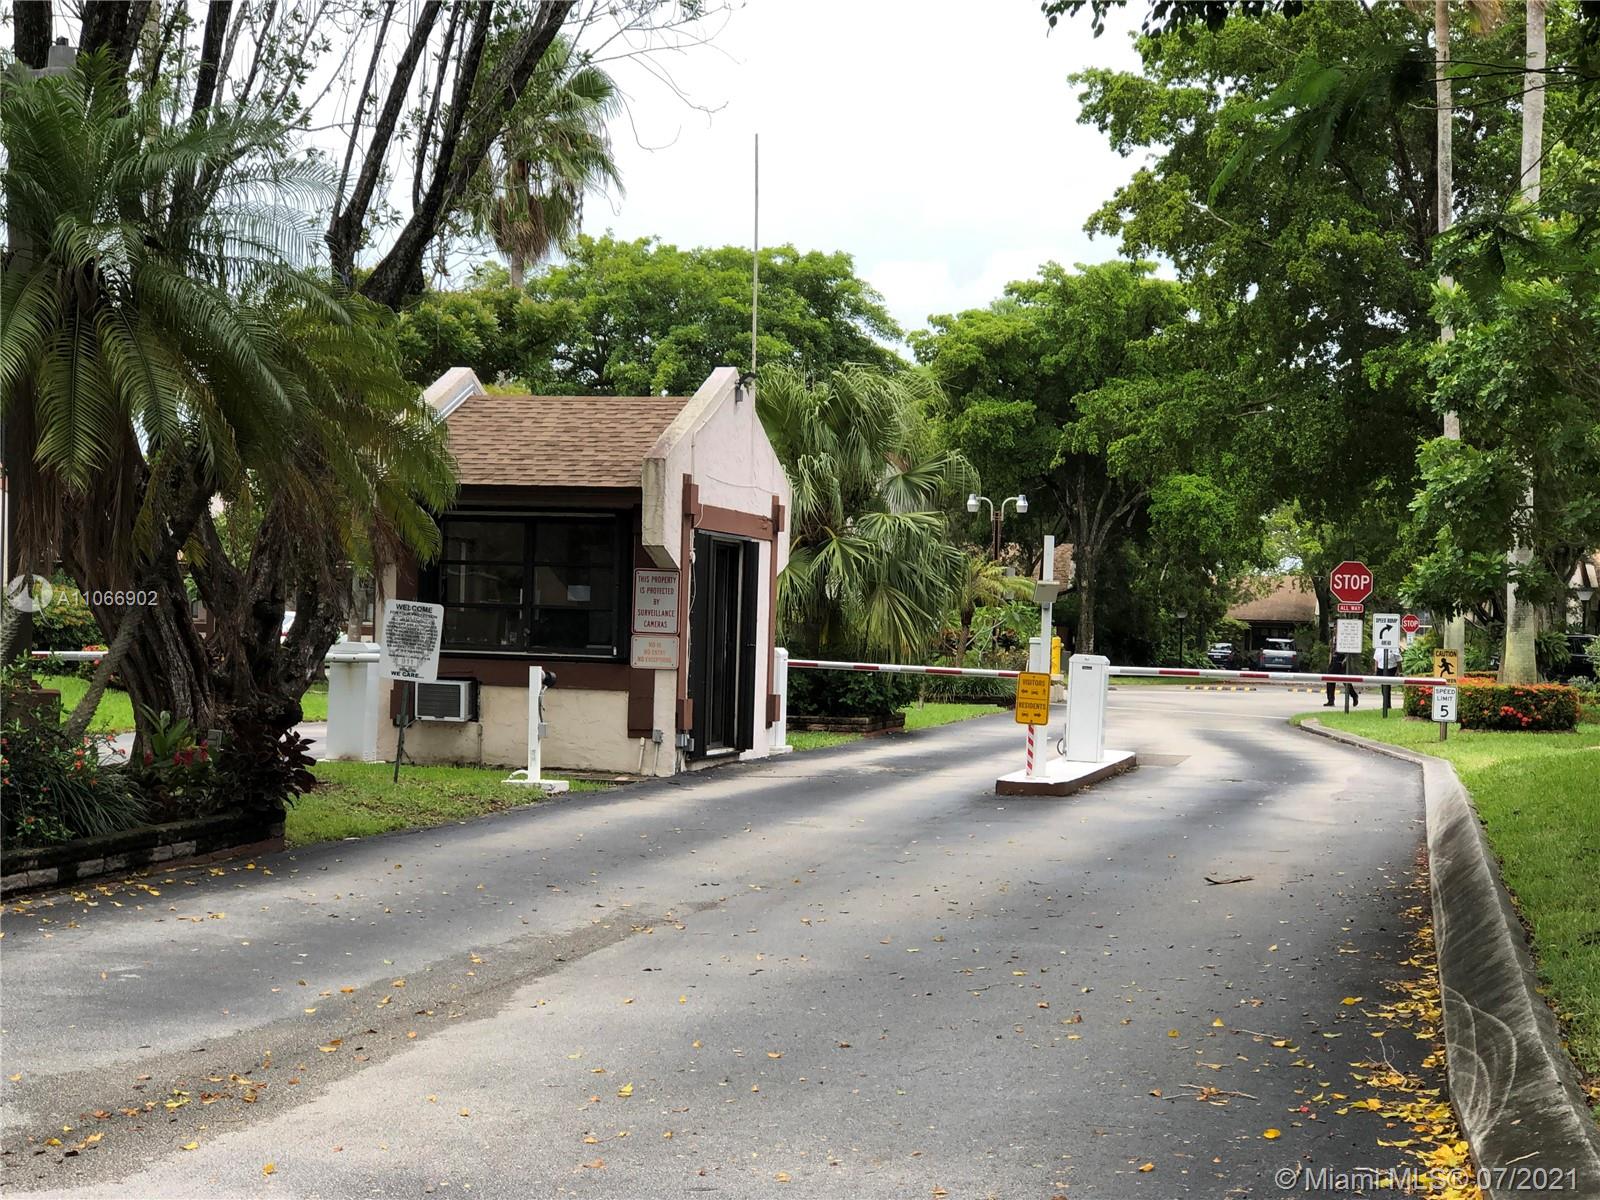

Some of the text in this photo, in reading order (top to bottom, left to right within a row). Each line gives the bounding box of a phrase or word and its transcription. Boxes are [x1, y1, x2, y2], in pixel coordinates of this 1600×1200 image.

[651, 576, 677, 584] PROPERTY
[1333, 574, 1370, 590] STOP
[646, 587, 675, 595] PROTECTED
[396, 603, 433, 613] WELCOME
[637, 609, 675, 618] SURVEILLANCE
[643, 619, 668, 628] CAMERAS
[1403, 619, 1418, 627] STOP
[1022, 679, 1045, 687] VISITORS
[1019, 702, 1046, 710] RESIDENTS
[1440, 704, 1449, 718] 5
